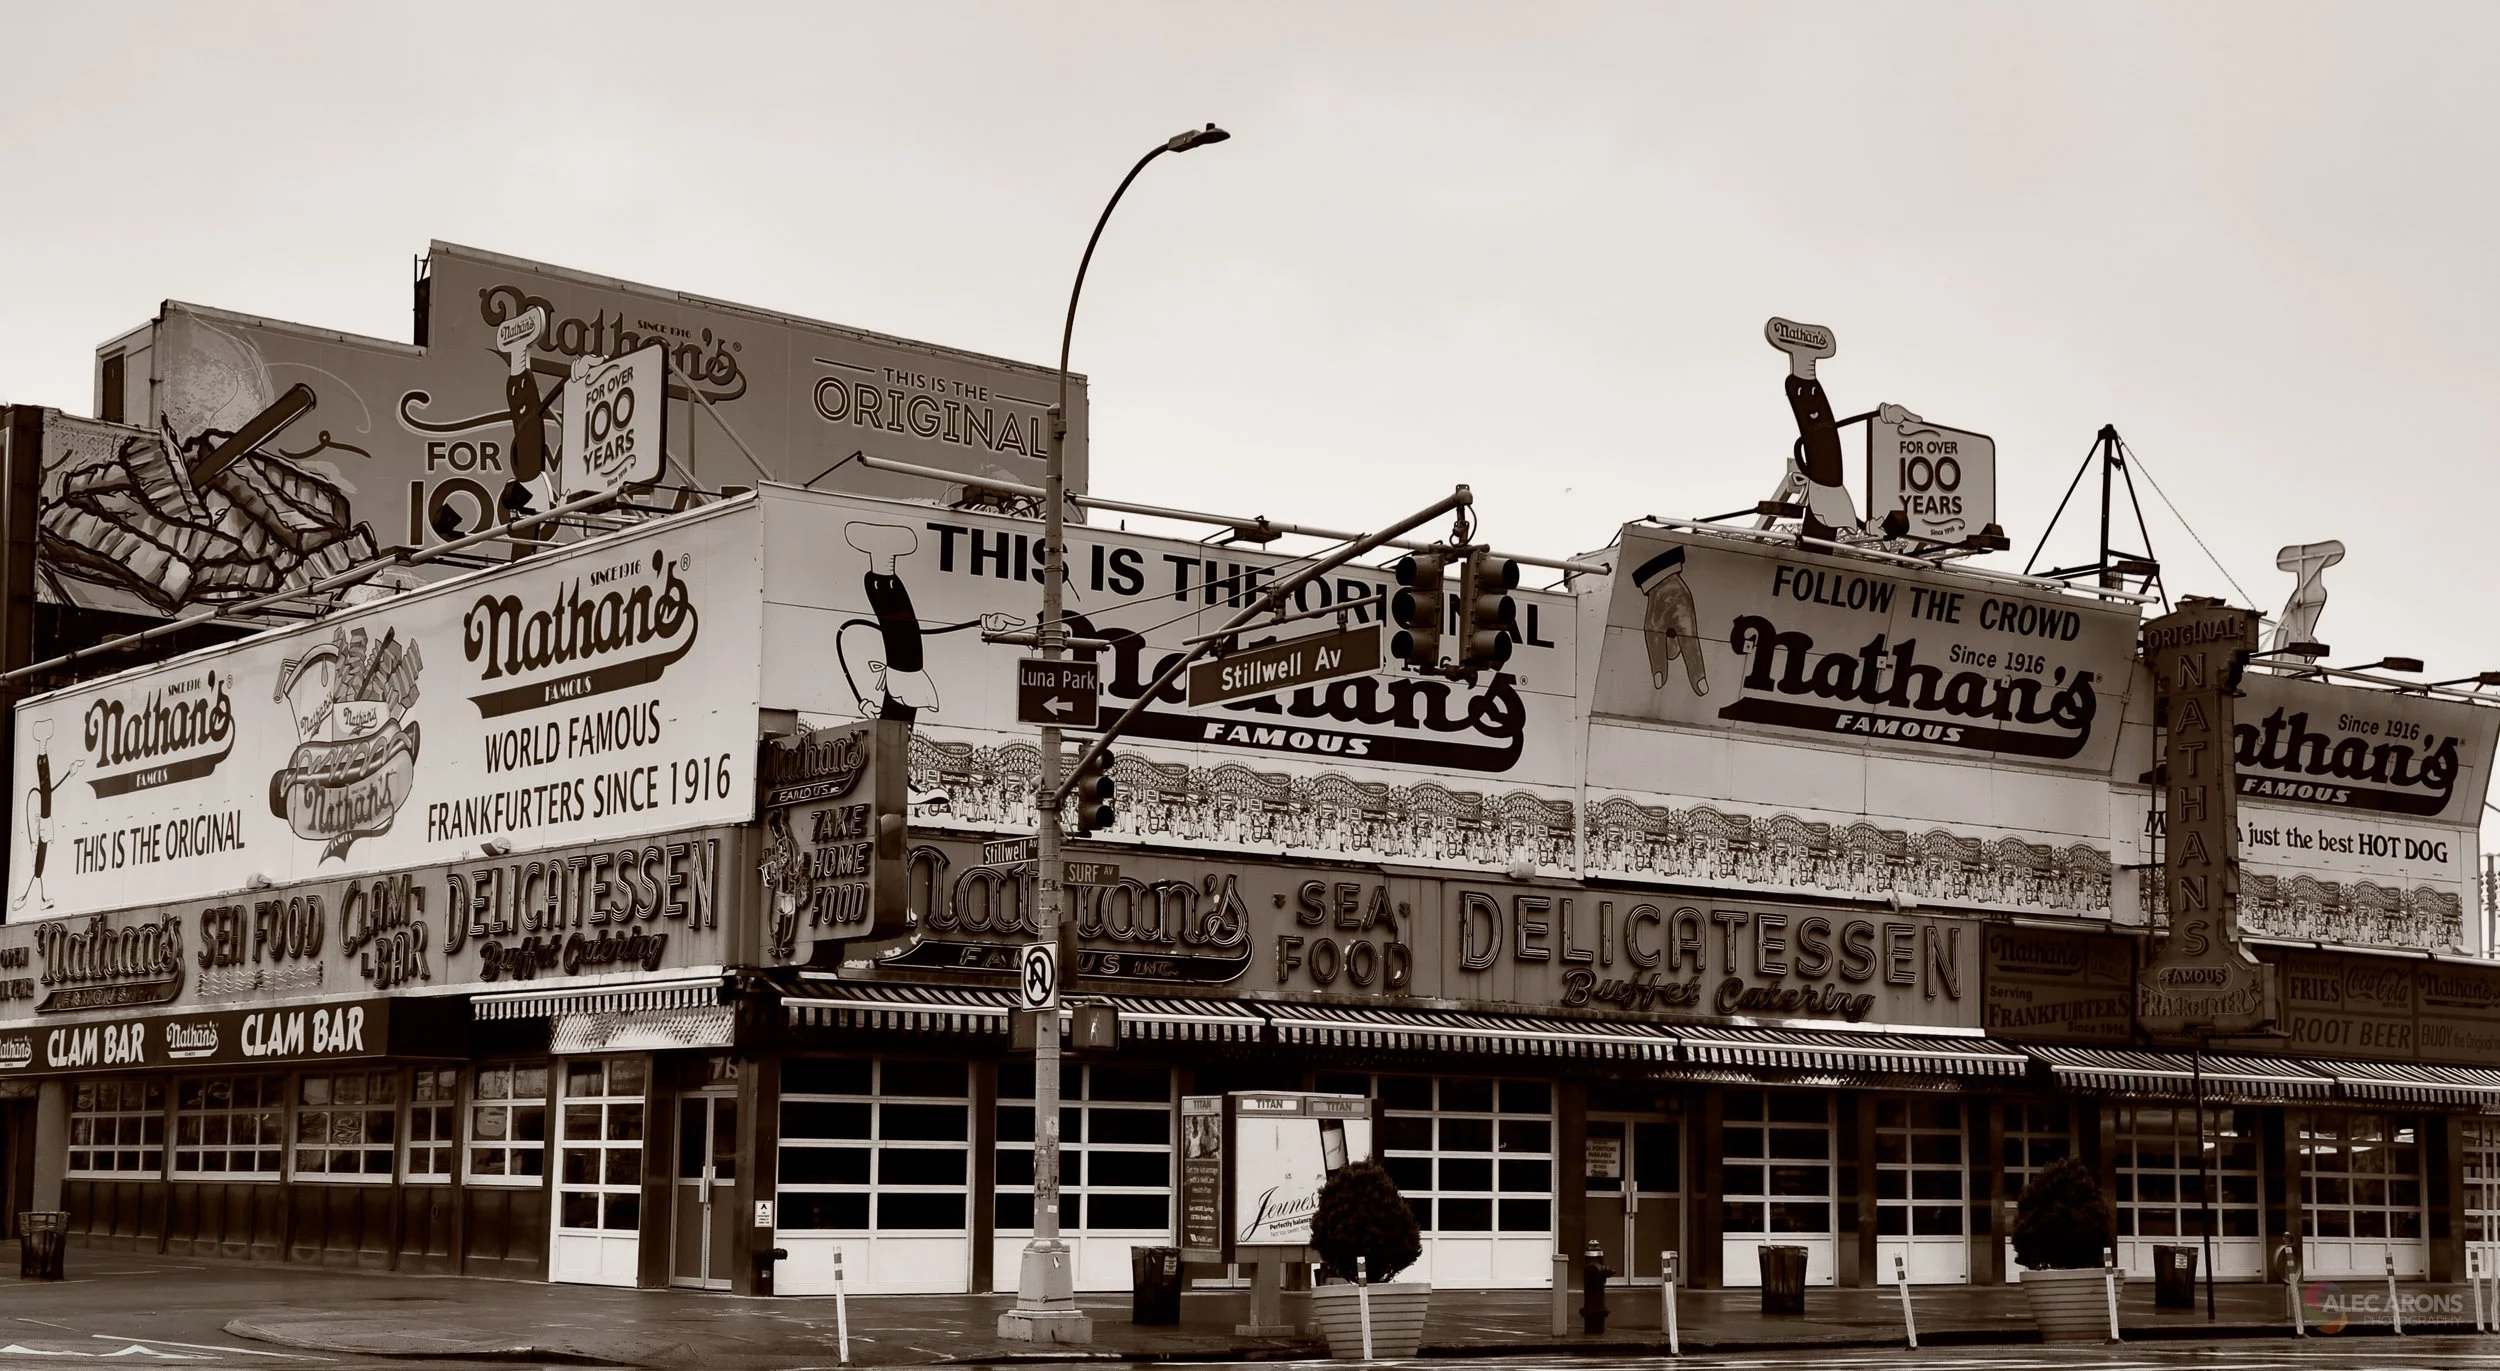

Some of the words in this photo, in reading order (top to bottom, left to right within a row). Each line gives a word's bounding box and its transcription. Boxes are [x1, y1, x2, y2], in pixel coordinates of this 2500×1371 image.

[637, 319, 668, 335] SINCE
[669, 326, 692, 340] 1916
[1774, 322, 1826, 345] Nathan's
[586, 383, 605, 408] FOR
[607, 366, 634, 393] OVER
[883, 367, 926, 389] THIS
[931, 377, 946, 392] IS
[952, 381, 988, 401] THE
[584, 387, 635, 452] 100
[813, 376, 1047, 459] ORIGINAL
[426, 441, 502, 472] FOR
[583, 429, 634, 475] YEARS
[1900, 441, 1924, 454] FOR
[1927, 441, 1958, 454] OVER
[1899, 456, 1961, 493] 100
[1898, 495, 1962, 515] YEARS
[590, 567, 618, 587] SINCE
[618, 559, 642, 579] 1916
[927, 522, 1069, 585] THIS
[1090, 544, 1145, 596] IS
[463, 549, 699, 681] Nathan's
[1772, 565, 1896, 614] FOLLOW
[1909, 586, 1964, 625] THE
[1979, 598, 2081, 642] CROWD
[2148, 615, 2239, 649] ORIGINAL
[1221, 652, 1301, 691] Stillwell
[1314, 645, 1341, 672] Av
[1730, 615, 2098, 731] Nathan's
[1949, 643, 1997, 669] Since
[2004, 651, 2046, 675] 1916
[544, 676, 593, 702] FAMOUS
[1021, 668, 1055, 688] Luna
[1063, 670, 1096, 690] Park
[84, 670, 235, 768] Nathan's
[301, 690, 333, 736] Nathan's
[344, 706, 377, 727] Nathan's
[1835, 714, 1964, 743] FAMOUS
[2338, 714, 2380, 735] Since
[2385, 720, 2420, 740] 1916
[485, 721, 560, 774] WORLD
[568, 699, 661, 759] FAMOUS
[1203, 723, 1371, 755] FAMOUS
[2234, 707, 2458, 790] athan's
[136, 768, 168, 787] FAMOUS
[2242, 778, 2351, 803] FAMOUS
[304, 772, 393, 833] Nathan's
[427, 778, 585, 843] FRANKFURTERS
[593, 765, 659, 819] SINCE
[670, 752, 731, 805] 1916
[811, 804, 871, 842] TAKE
[74, 832, 107, 875] THIS
[111, 829, 125, 869] IS
[130, 824, 161, 865] THE
[165, 809, 246, 860] ORIGINAL
[985, 840, 1027, 864] Stillwell
[2248, 822, 2281, 848] just
[2286, 827, 2313, 849] the
[2318, 830, 2354, 853] best
[2358, 833, 2401, 858] HOT
[2404, 838, 2449, 864] DOG
[811, 842, 873, 879] HOME
[1069, 863, 1099, 883] SURF
[1103, 866, 1114, 876] AV
[443, 838, 720, 954] DELICATESSEN
[809, 882, 868, 927] FOOD
[1297, 880, 1399, 932] SEA
[198, 904, 247, 969] SEA
[252, 894, 325, 962] FOOD
[339, 872, 412, 957] CLAM
[34, 913, 183, 985] Nathan's
[373, 920, 431, 989] BAR
[479, 933, 562, 982] Buffet
[563, 925, 668, 975] Catering
[1277, 935, 1412, 988] FOOD
[1460, 890, 1962, 999] DELICATESSEN
[1991, 935, 2081, 966] Nathan's
[1990, 986, 2032, 1002] Serving
[2166, 969, 2227, 985] FAMOUS
[2291, 977, 2340, 1002] FRIES
[2419, 971, 2492, 1000] Nathan's
[1563, 967, 1701, 1011] Buffet
[1715, 977, 1876, 1023] Catering
[1988, 994, 2130, 1027] FRANKFURTERS
[2138, 981, 2257, 1016] FRANKFURTERS
[166, 1020, 219, 1052] Nathan's
[241, 1009, 305, 1058] CLAM
[312, 1006, 365, 1053] BAR
[2068, 1021, 2097, 1034] Since
[2292, 1017, 2354, 1044] ROOT
[2360, 1022, 2412, 1049] BEER
[2422, 1024, 2453, 1047] ENJOY
[47, 1027, 98, 1069] CLAM
[104, 1022, 145, 1065] BAR
[1193, 1100, 1212, 1109] TITAN
[1256, 1099, 1283, 1110] TITAN
[1327, 1101, 1353, 1112] TITAN
[1269, 1220, 1292, 1230] Perfectly
